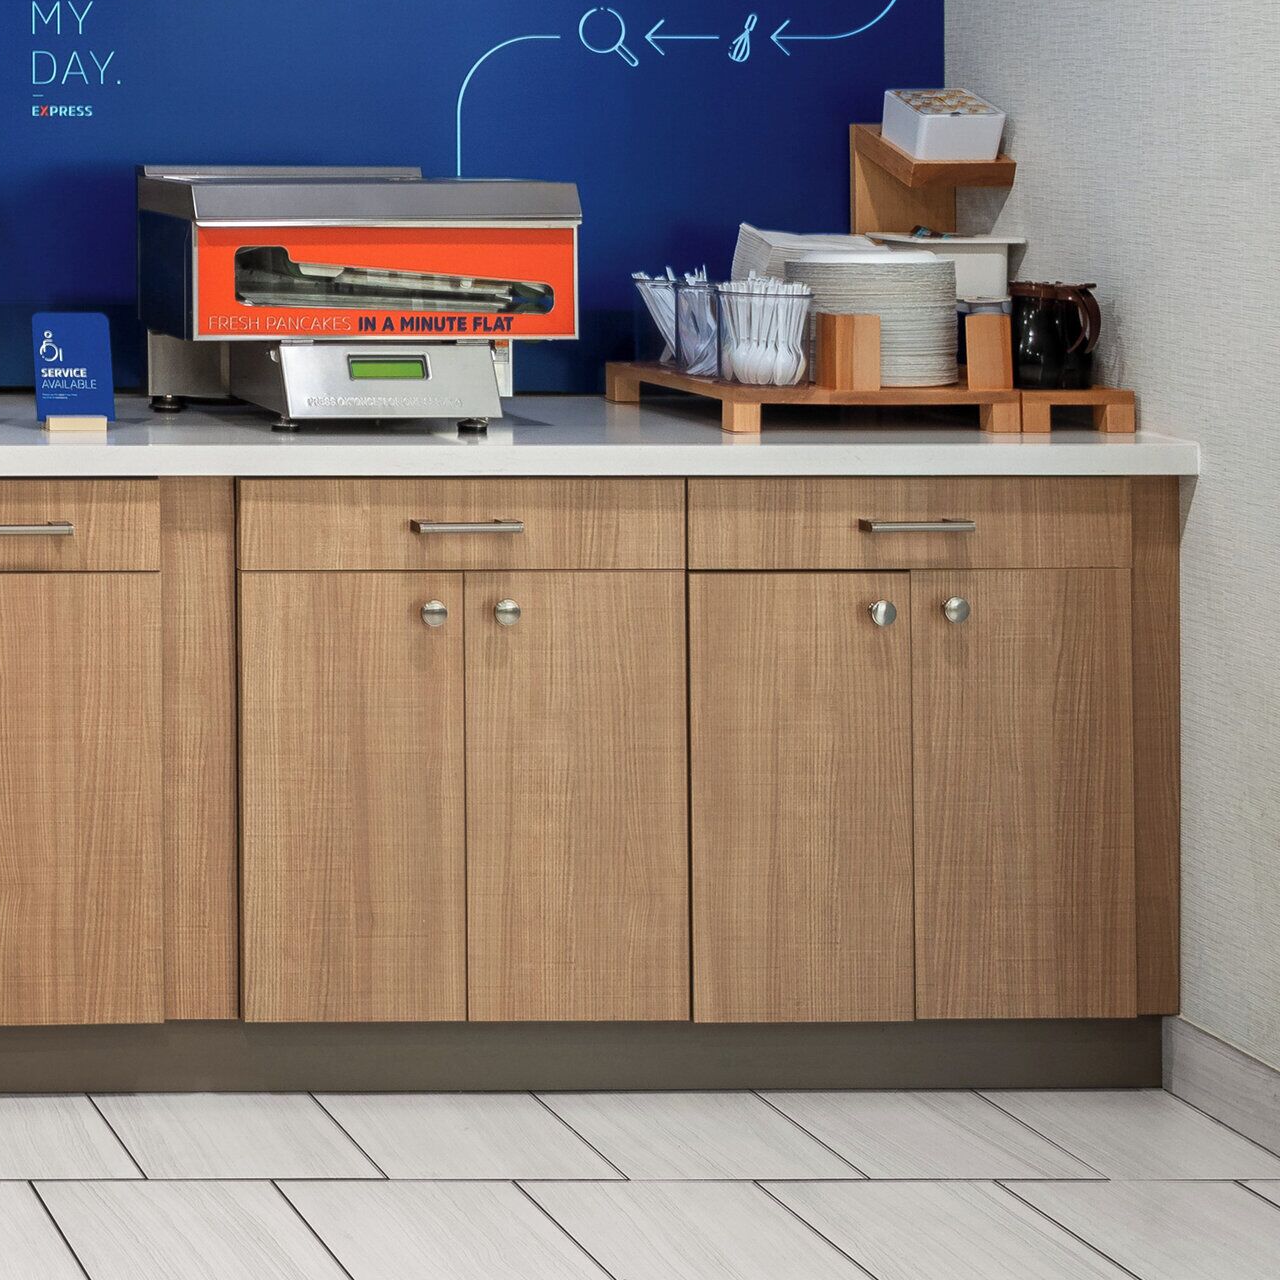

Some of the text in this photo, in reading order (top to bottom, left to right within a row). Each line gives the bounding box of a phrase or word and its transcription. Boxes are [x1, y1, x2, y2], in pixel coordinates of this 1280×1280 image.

[31, 0, 93, 36] MY
[31, 50, 122, 85] DAY.
[31, 105, 93, 117] EXPRESS
[208, 317, 514, 333] FRESH PANCAKES IN A MINUTE FLAT
[41, 368, 87, 378] SERVICE
[41, 379, 97, 390] AVAILABLE
